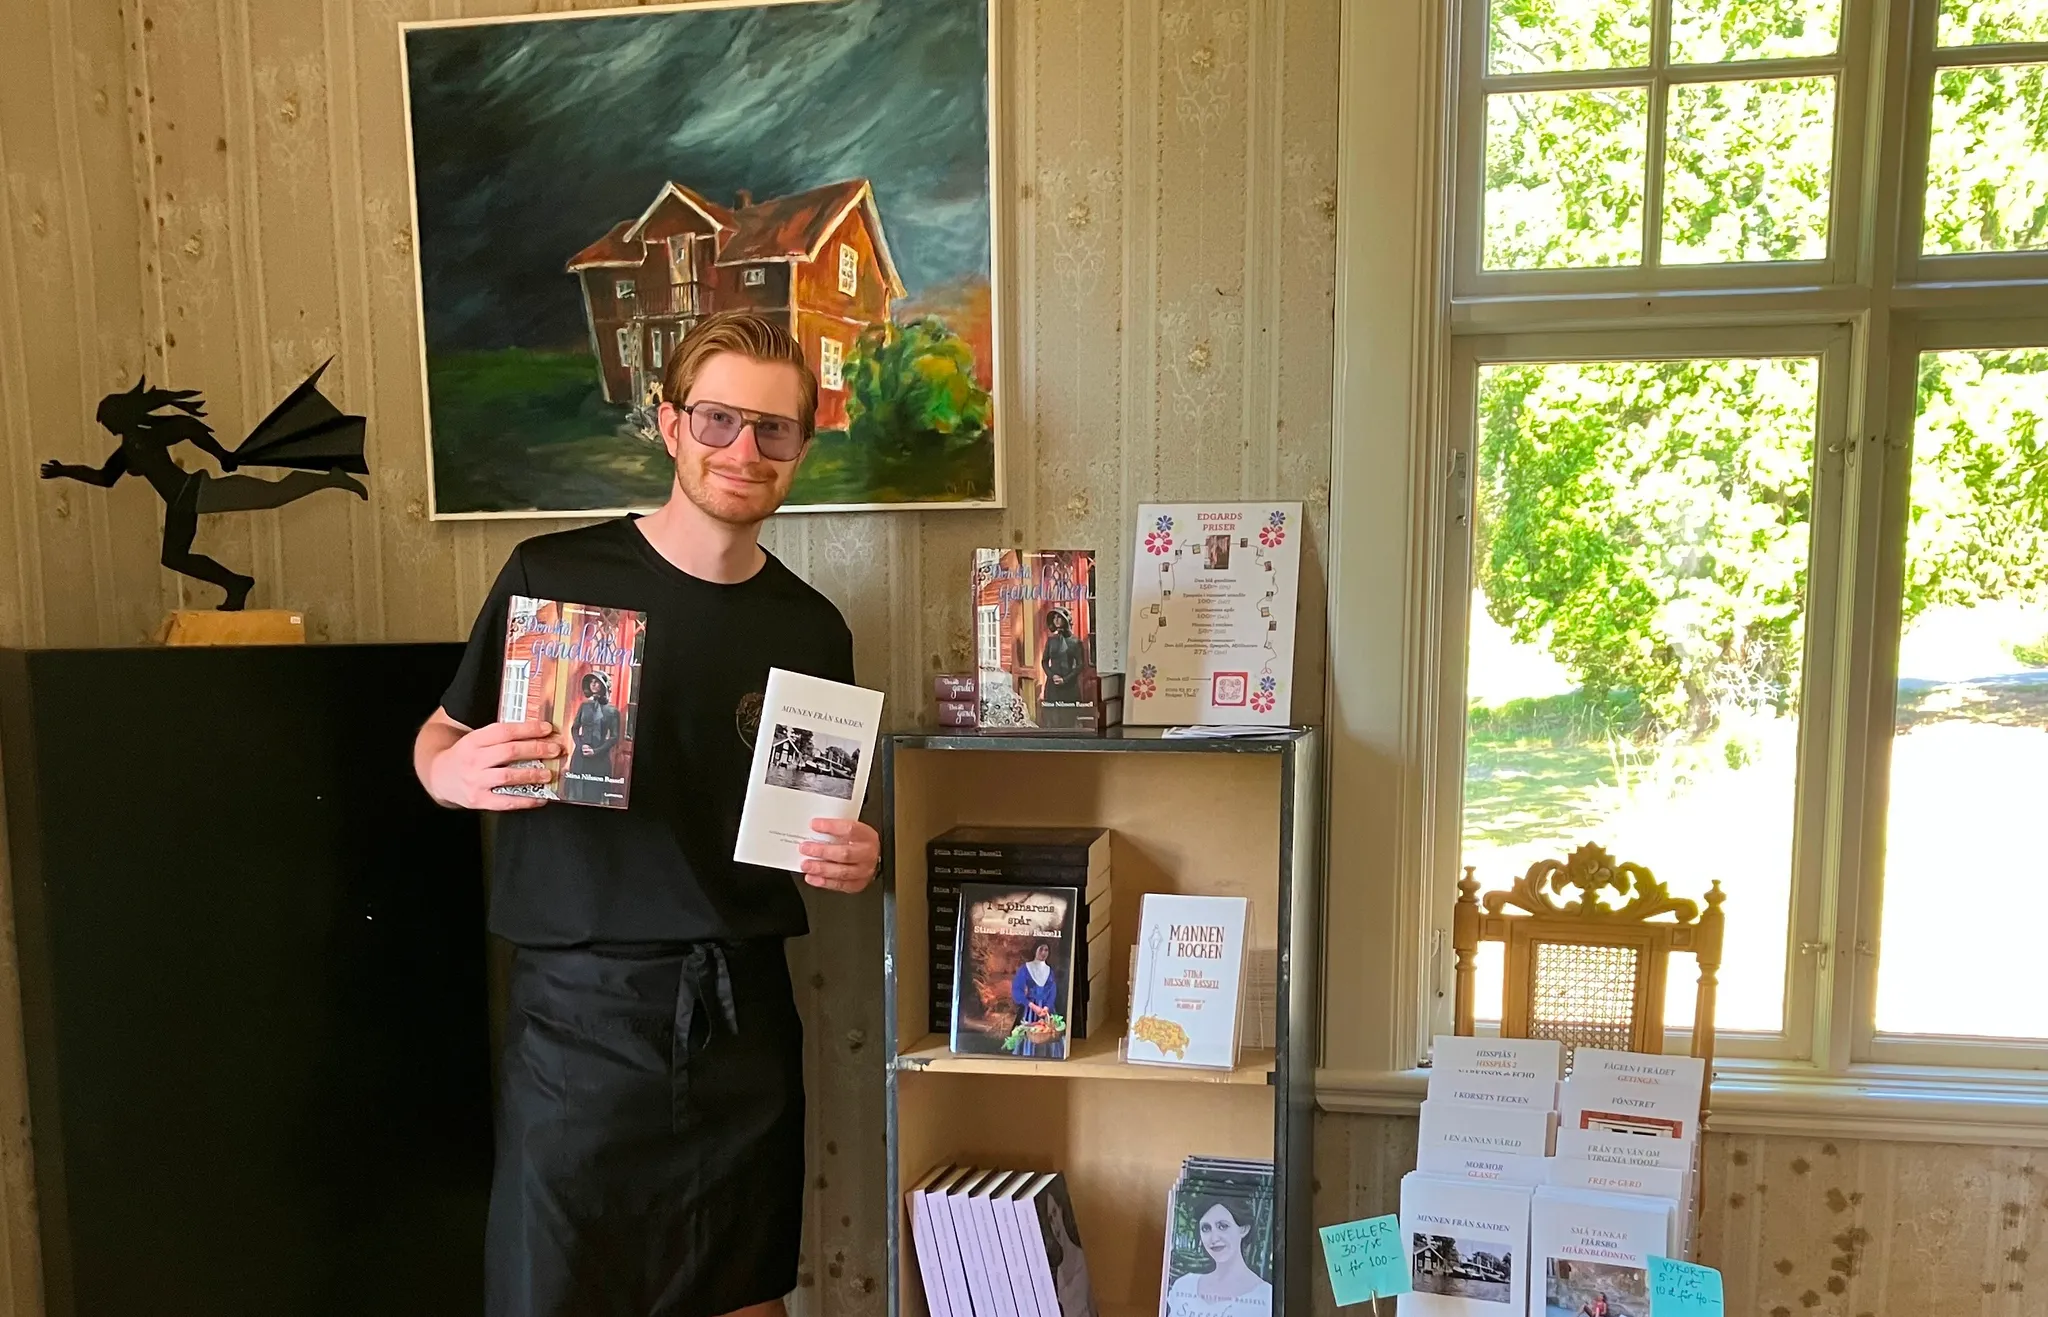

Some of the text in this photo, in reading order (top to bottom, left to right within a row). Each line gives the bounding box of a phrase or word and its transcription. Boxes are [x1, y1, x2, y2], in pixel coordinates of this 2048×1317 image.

[1196, 512, 1243, 521] EDGARDS
[1203, 523, 1236, 531] PRISER
[781, 705, 865, 728] MINNEN FRÅN SANDEN
[1007, 915, 1032, 927] spår
[973, 925, 997, 934] Stina
[1169, 924, 1225, 943] MANNEN
[1167, 942, 1223, 959] I ROCKEN
[1512, 1071, 1535, 1079] ECHO
[1617, 1075, 1660, 1085] GETINGEN
[1458, 1092, 1495, 1101] KORSETS
[1496, 1095, 1529, 1104] TECKEN
[1611, 1096, 1656, 1109] FÖNSTRET
[1449, 1134, 1461, 1142] EN
[1461, 1136, 1492, 1145] ANNAN
[1494, 1138, 1522, 1147] VÄRLD
[1587, 1144, 1611, 1154] FRÅN
[1612, 1147, 1625, 1155] EN
[1645, 1150, 1660, 1158] OM
[1464, 1160, 1504, 1171] MORMOR
[1587, 1154, 1660, 1167] VIRGINIA WOOLF
[1467, 1170, 1500, 1180] GLASET
[1587, 1176, 1642, 1188] FREJ & GERD
[1416, 1213, 1511, 1232] MINNEN FRÅN SANDEN
[1326, 1221, 1393, 1244] NOVELLER
[1570, 1226, 1628, 1240] SMÅ TANKAR
[1561, 1245, 1636, 1261] HJÄRNBLÖDNING
[1334, 1263, 1343, 1276] 4
[1349, 1259, 1364, 1277] för
[1662, 1261, 1713, 1279] VYKORT
[1175, 1291, 1197, 1299] STINA
[1655, 1286, 1666, 1295] 10
[1677, 1289, 1693, 1304] för
